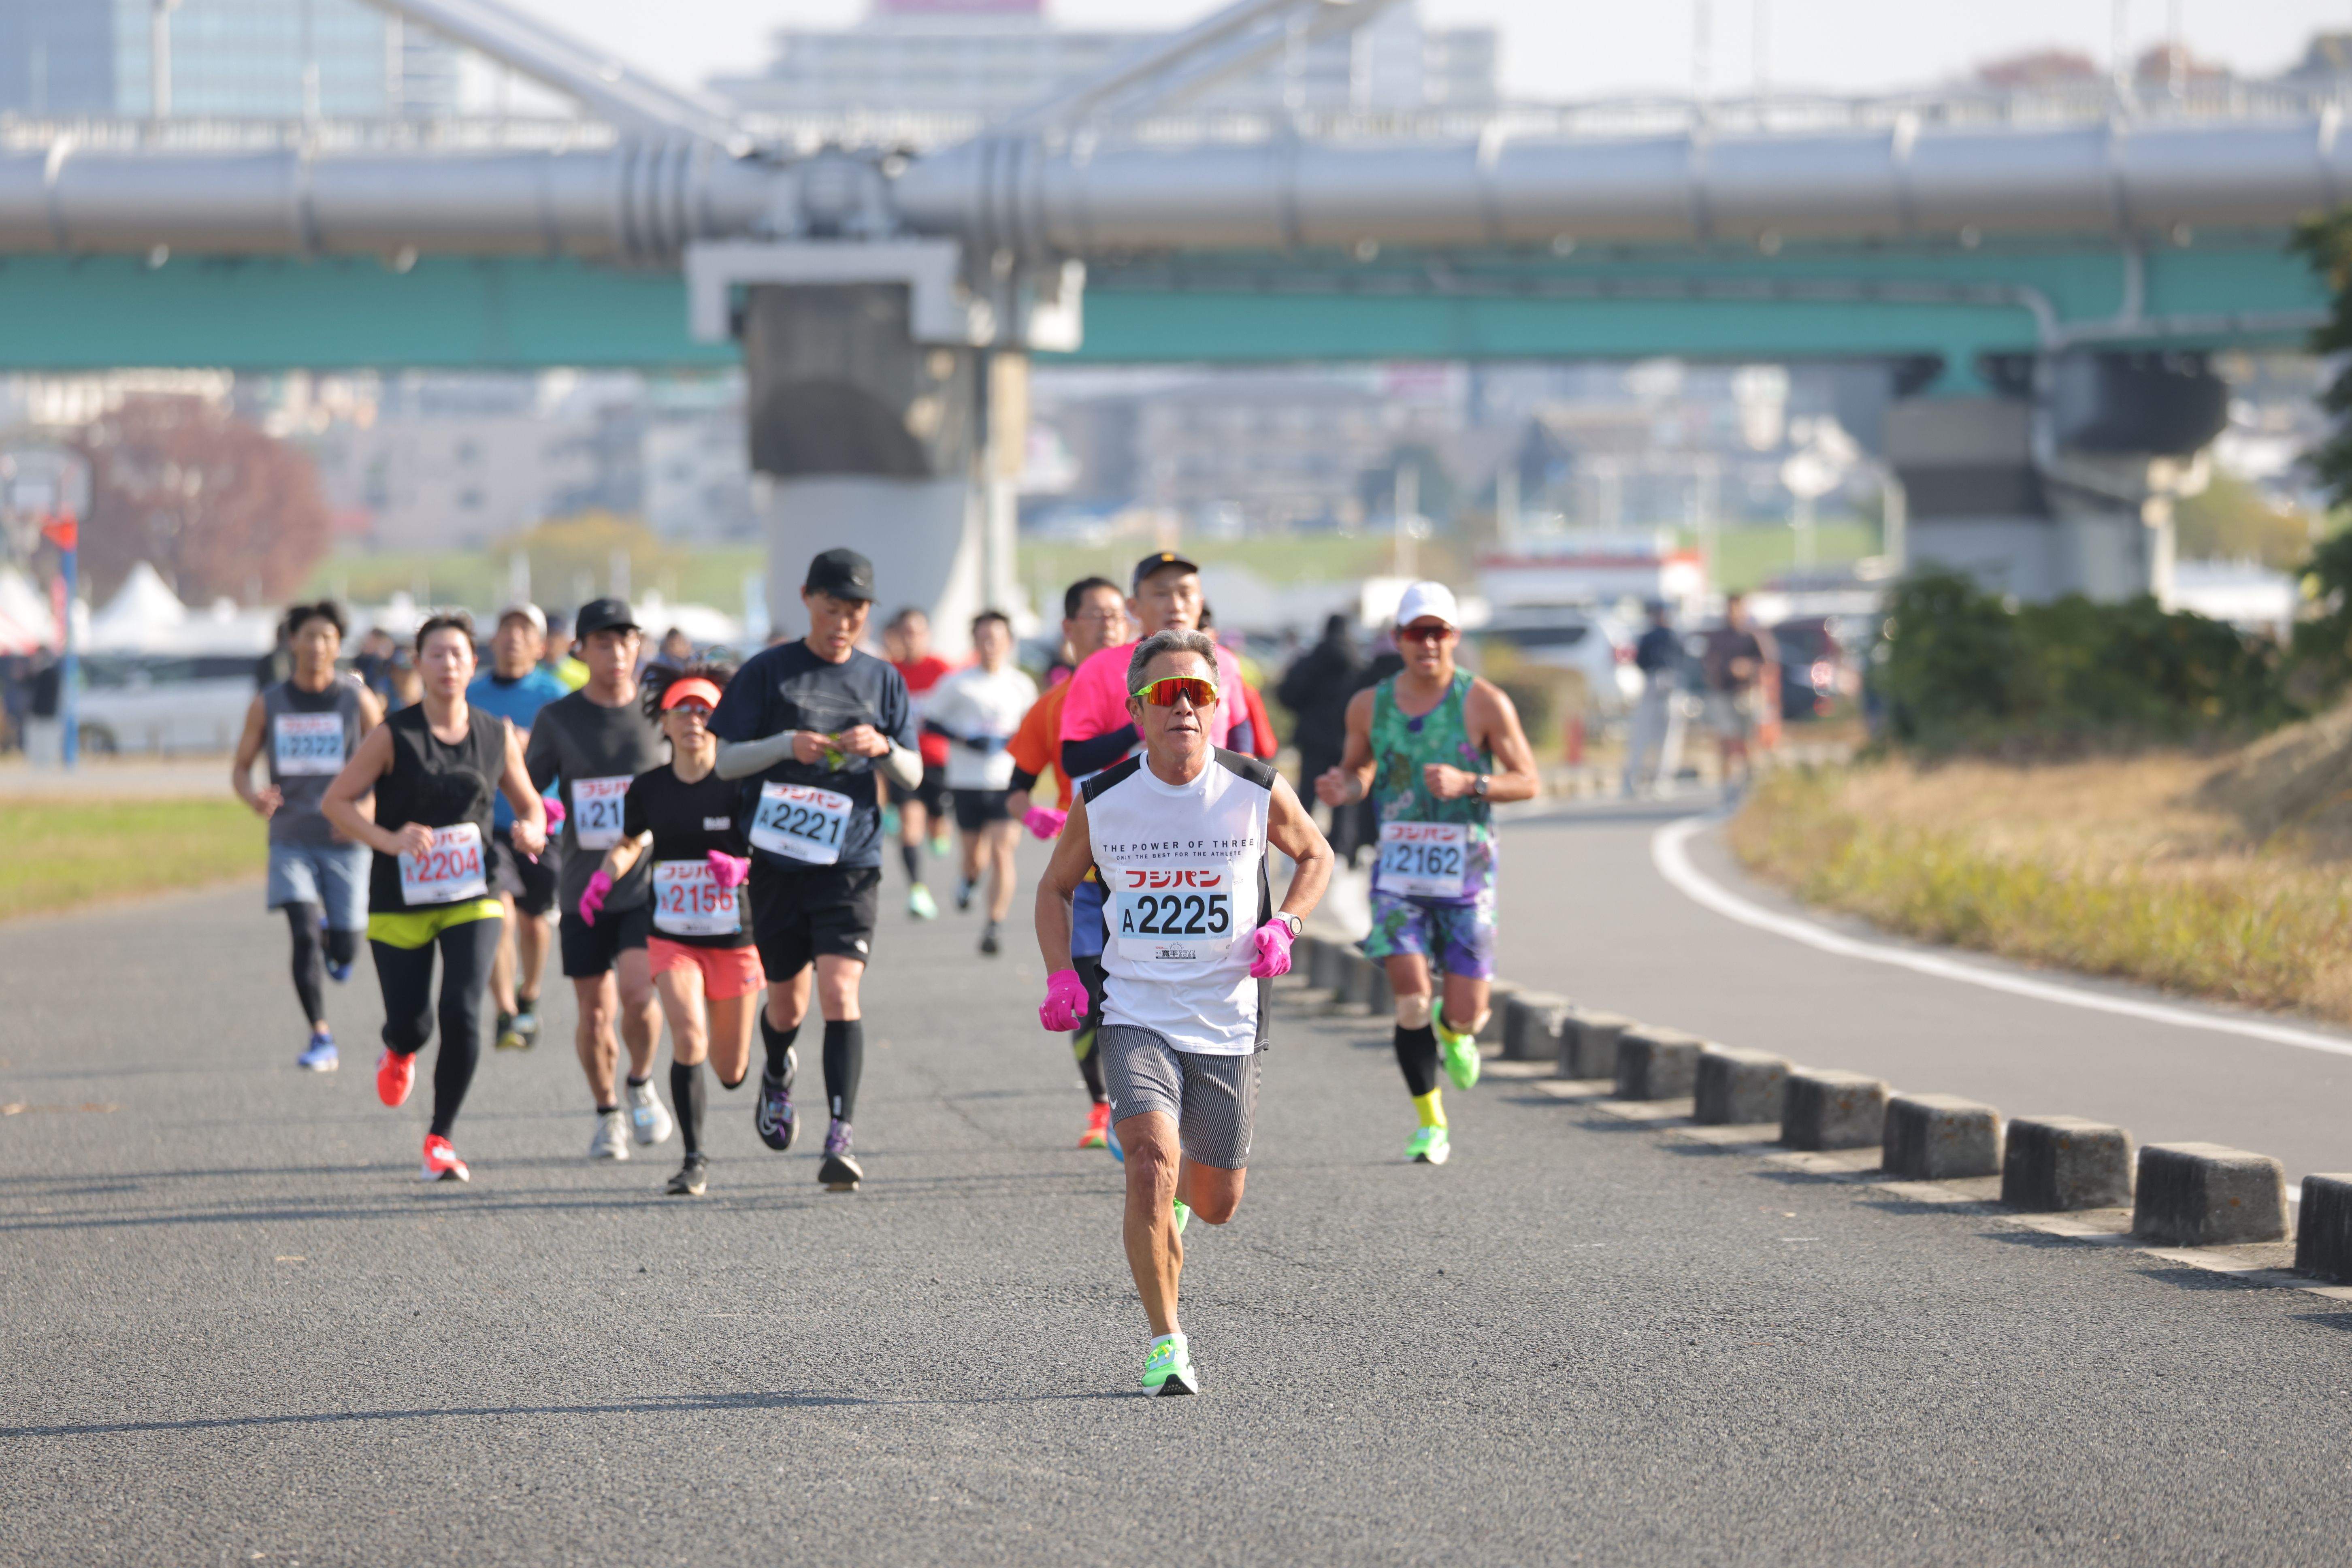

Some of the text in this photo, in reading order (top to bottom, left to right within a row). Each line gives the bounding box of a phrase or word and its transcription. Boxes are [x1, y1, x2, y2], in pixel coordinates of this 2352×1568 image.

[580, 781, 631, 798] フジパ
[1132, 842, 1178, 851] POWER
[1213, 838, 1254, 848] THREE
[663, 865, 713, 880] フジパ
[1125, 870, 1221, 888] フジパン
